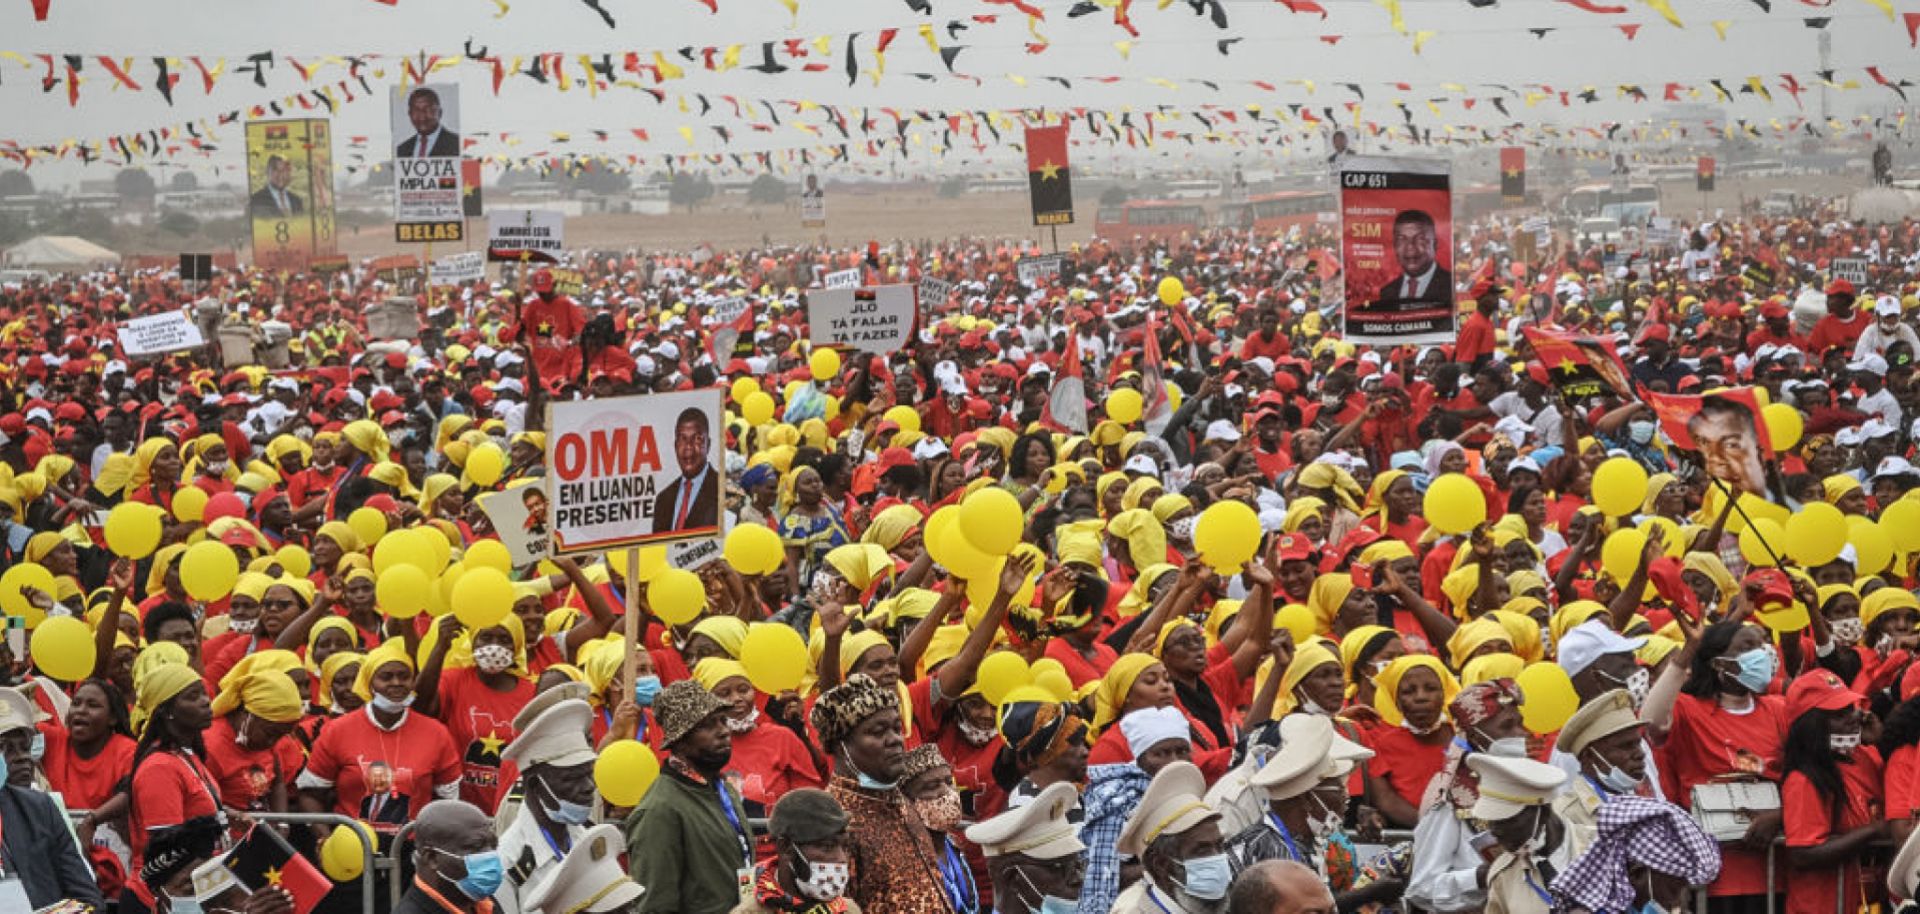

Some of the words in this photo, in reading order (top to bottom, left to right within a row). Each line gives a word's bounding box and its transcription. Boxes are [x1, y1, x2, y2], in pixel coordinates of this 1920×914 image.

[400, 159, 457, 177] VOTA
[400, 177, 437, 190] MPLA
[1345, 173, 1366, 187] CAP
[1369, 174, 1387, 188] 651
[400, 223, 459, 240] BELAS
[1351, 222, 1382, 238] SIM
[850, 303, 877, 314] JLO
[852, 314, 899, 327] FALAR
[1363, 323, 1392, 333] SOMOS
[1395, 320, 1433, 332] CAMAMA
[853, 329, 899, 340] FAZER
[554, 425, 662, 481] OMA
[559, 482, 584, 506] EM
[589, 474, 656, 502] LUANDA
[556, 499, 654, 529] PRESENTE
